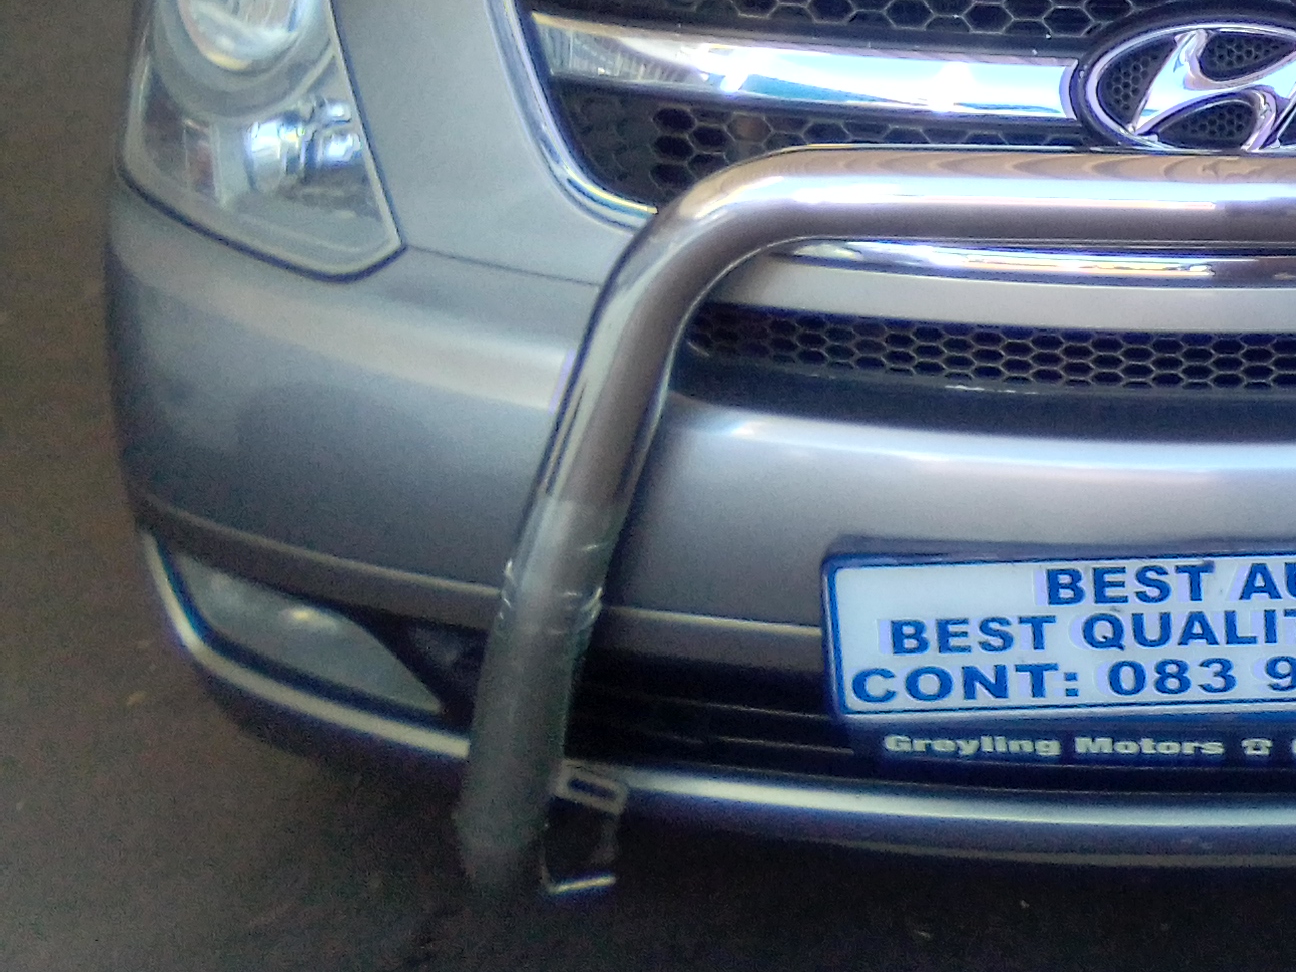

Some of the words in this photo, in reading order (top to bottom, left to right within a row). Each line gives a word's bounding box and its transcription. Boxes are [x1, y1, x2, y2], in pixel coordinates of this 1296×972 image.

[1047, 564, 1212, 605] BEST
[890, 615, 1057, 655] BEST
[851, 662, 1080, 703] CONT:
[1108, 657, 1237, 697] 083
[884, 734, 1062, 757] Greyling
[1075, 737, 1225, 756] Motors
